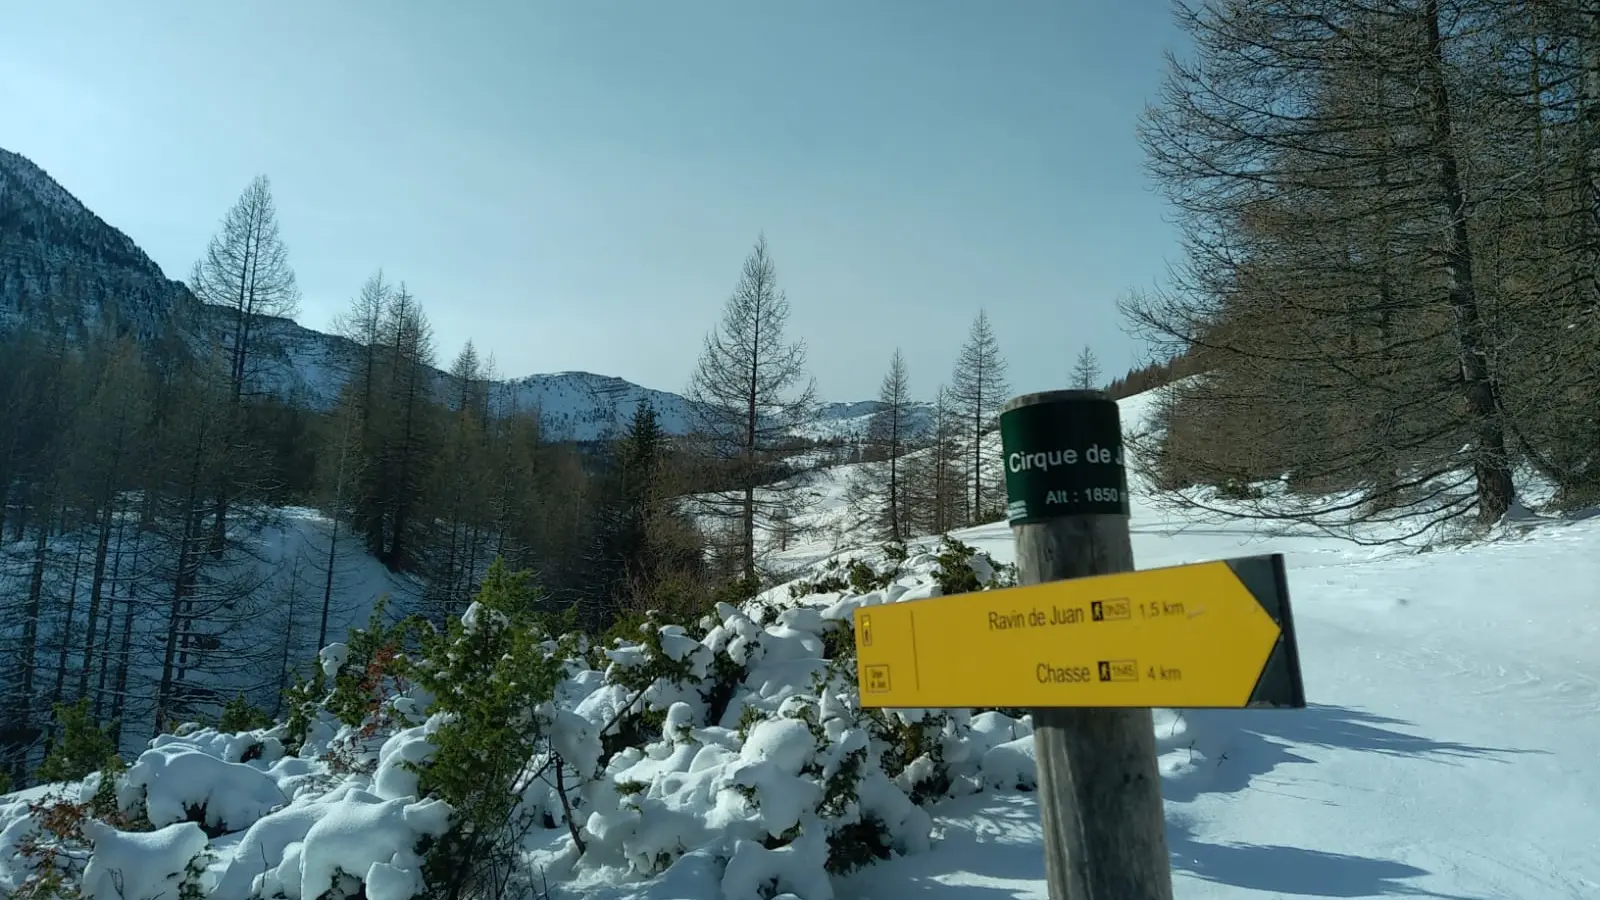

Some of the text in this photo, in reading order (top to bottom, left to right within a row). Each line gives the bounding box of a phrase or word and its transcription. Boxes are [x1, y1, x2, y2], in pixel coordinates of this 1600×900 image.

[1008, 448, 1078, 473] Cirque
[1086, 443, 1111, 464] de
[1046, 489, 1068, 504] Alt
[1084, 487, 1118, 502] 1850
[988, 609, 1025, 630] Ravin
[1029, 610, 1046, 627] de
[1050, 605, 1084, 625] Juan
[1162, 600, 1185, 616] km
[1036, 662, 1090, 684] Chasse
[1147, 665, 1157, 680] 4
[1160, 665, 1182, 681] km
